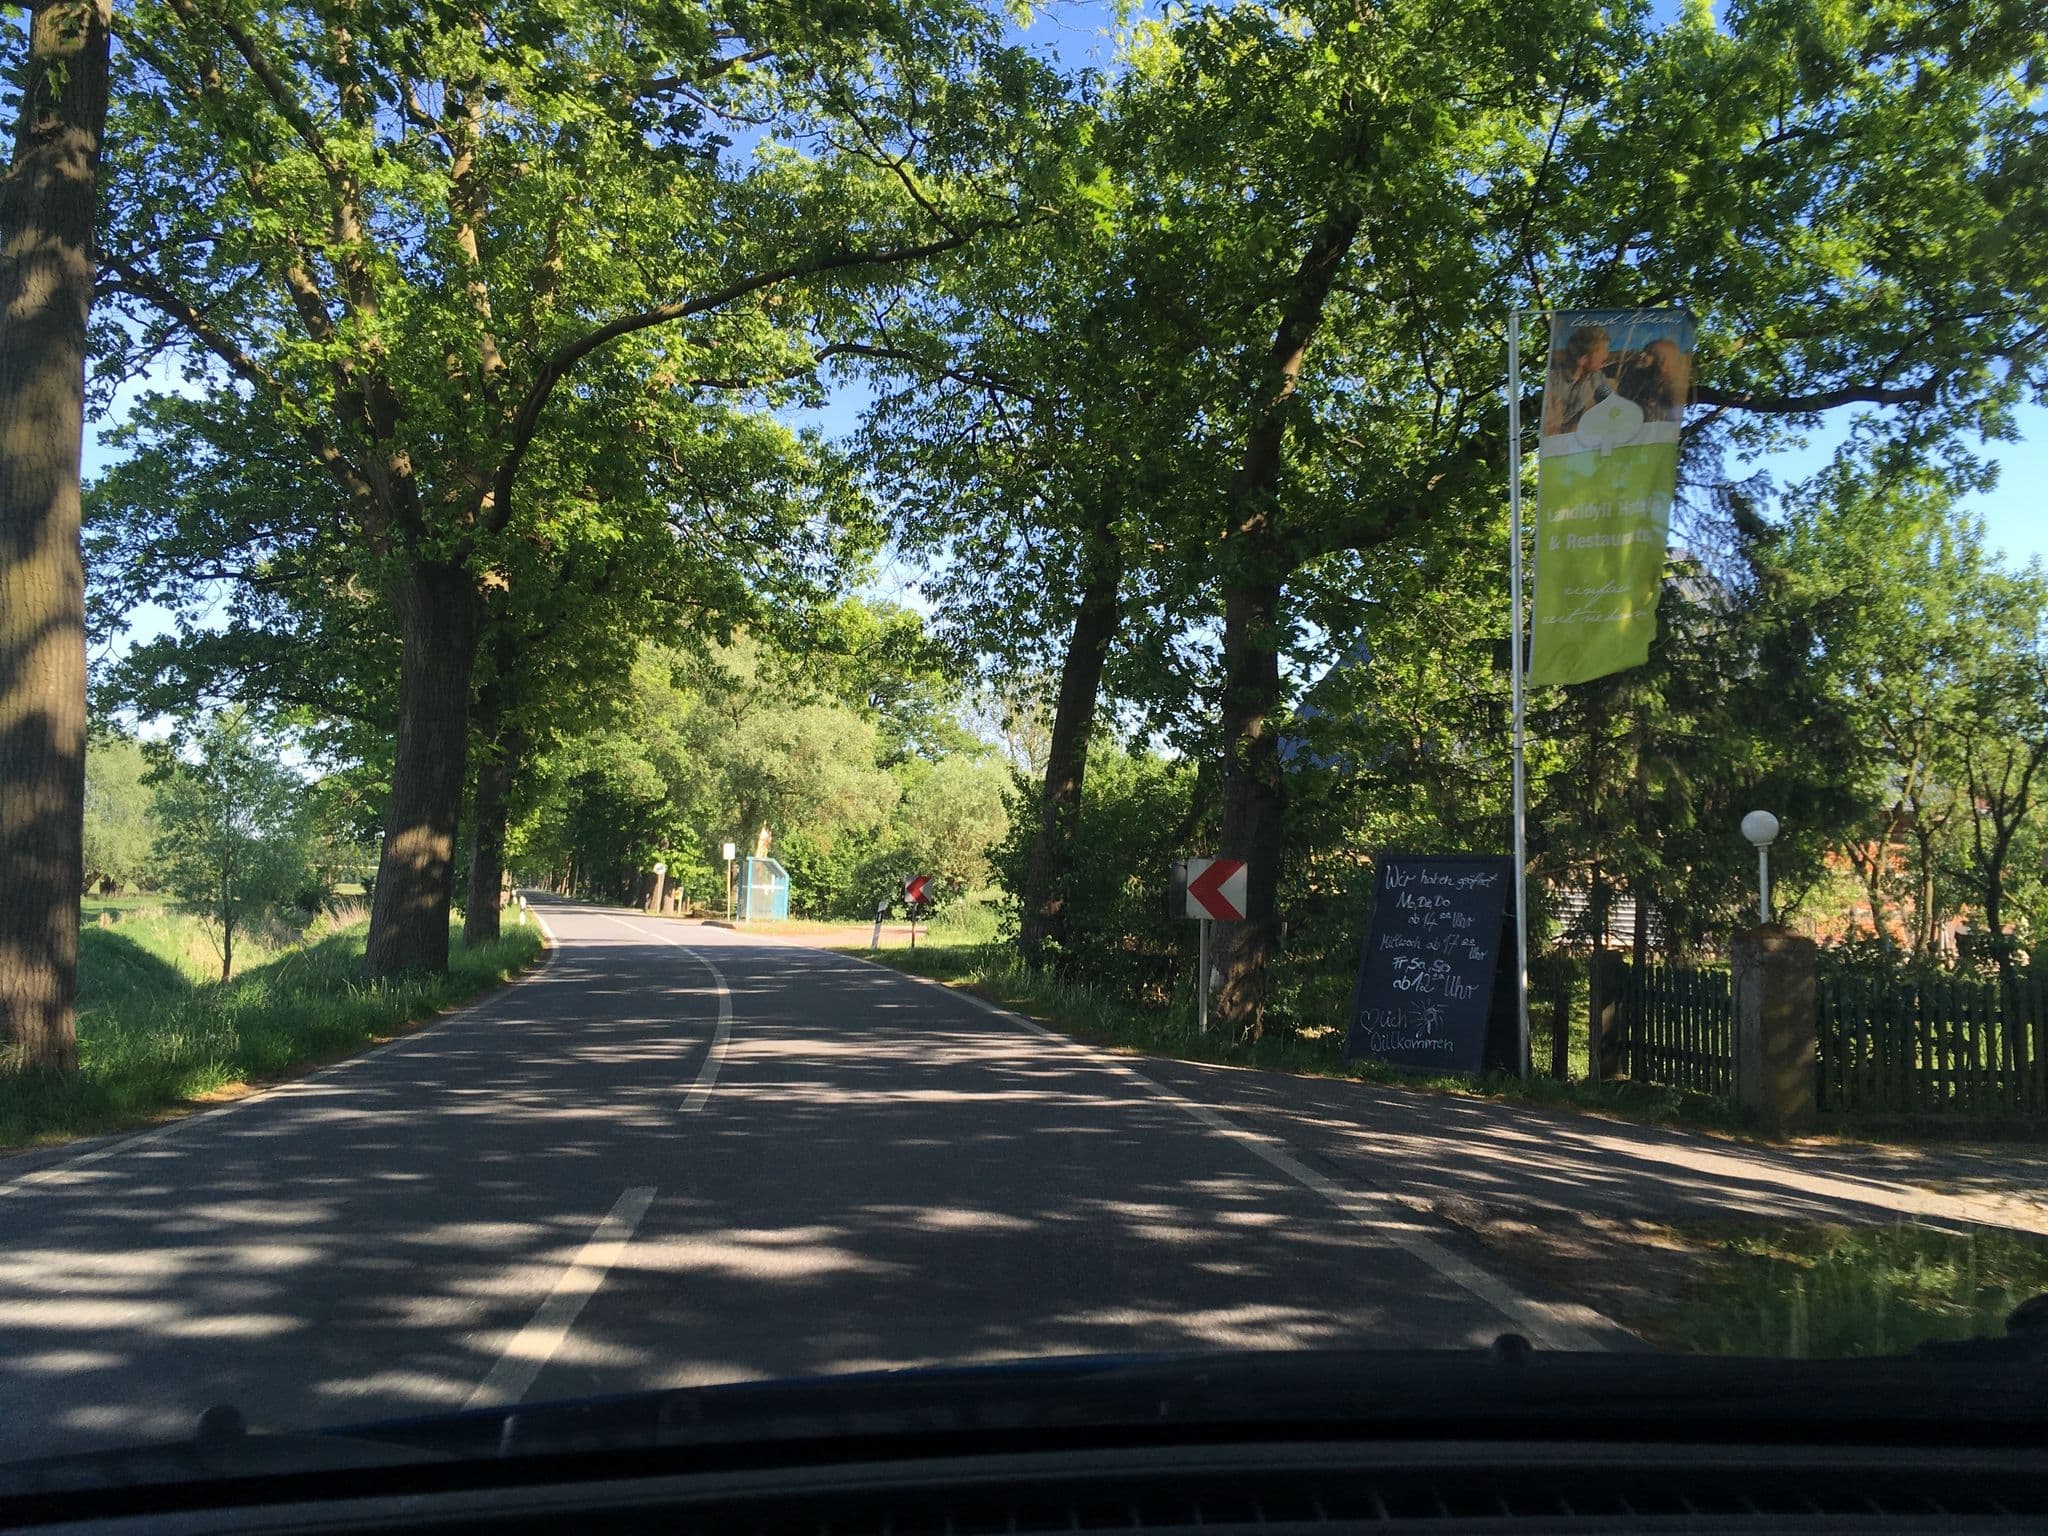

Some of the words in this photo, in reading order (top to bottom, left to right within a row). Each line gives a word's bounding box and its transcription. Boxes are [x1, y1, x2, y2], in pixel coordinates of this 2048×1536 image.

[1549, 536, 1560, 553] &
[1385, 865, 1416, 889] Wir
[1421, 869, 1455, 886] haben
[1408, 913, 1420, 924] ab
[1452, 912, 1475, 928] Uhr
[1425, 937, 1440, 951] ab
[1468, 946, 1488, 960] Uhr
[1392, 975, 1411, 991] ab
[1444, 975, 1479, 999] Uhr
[1370, 1031, 1453, 1052] Willkommen
